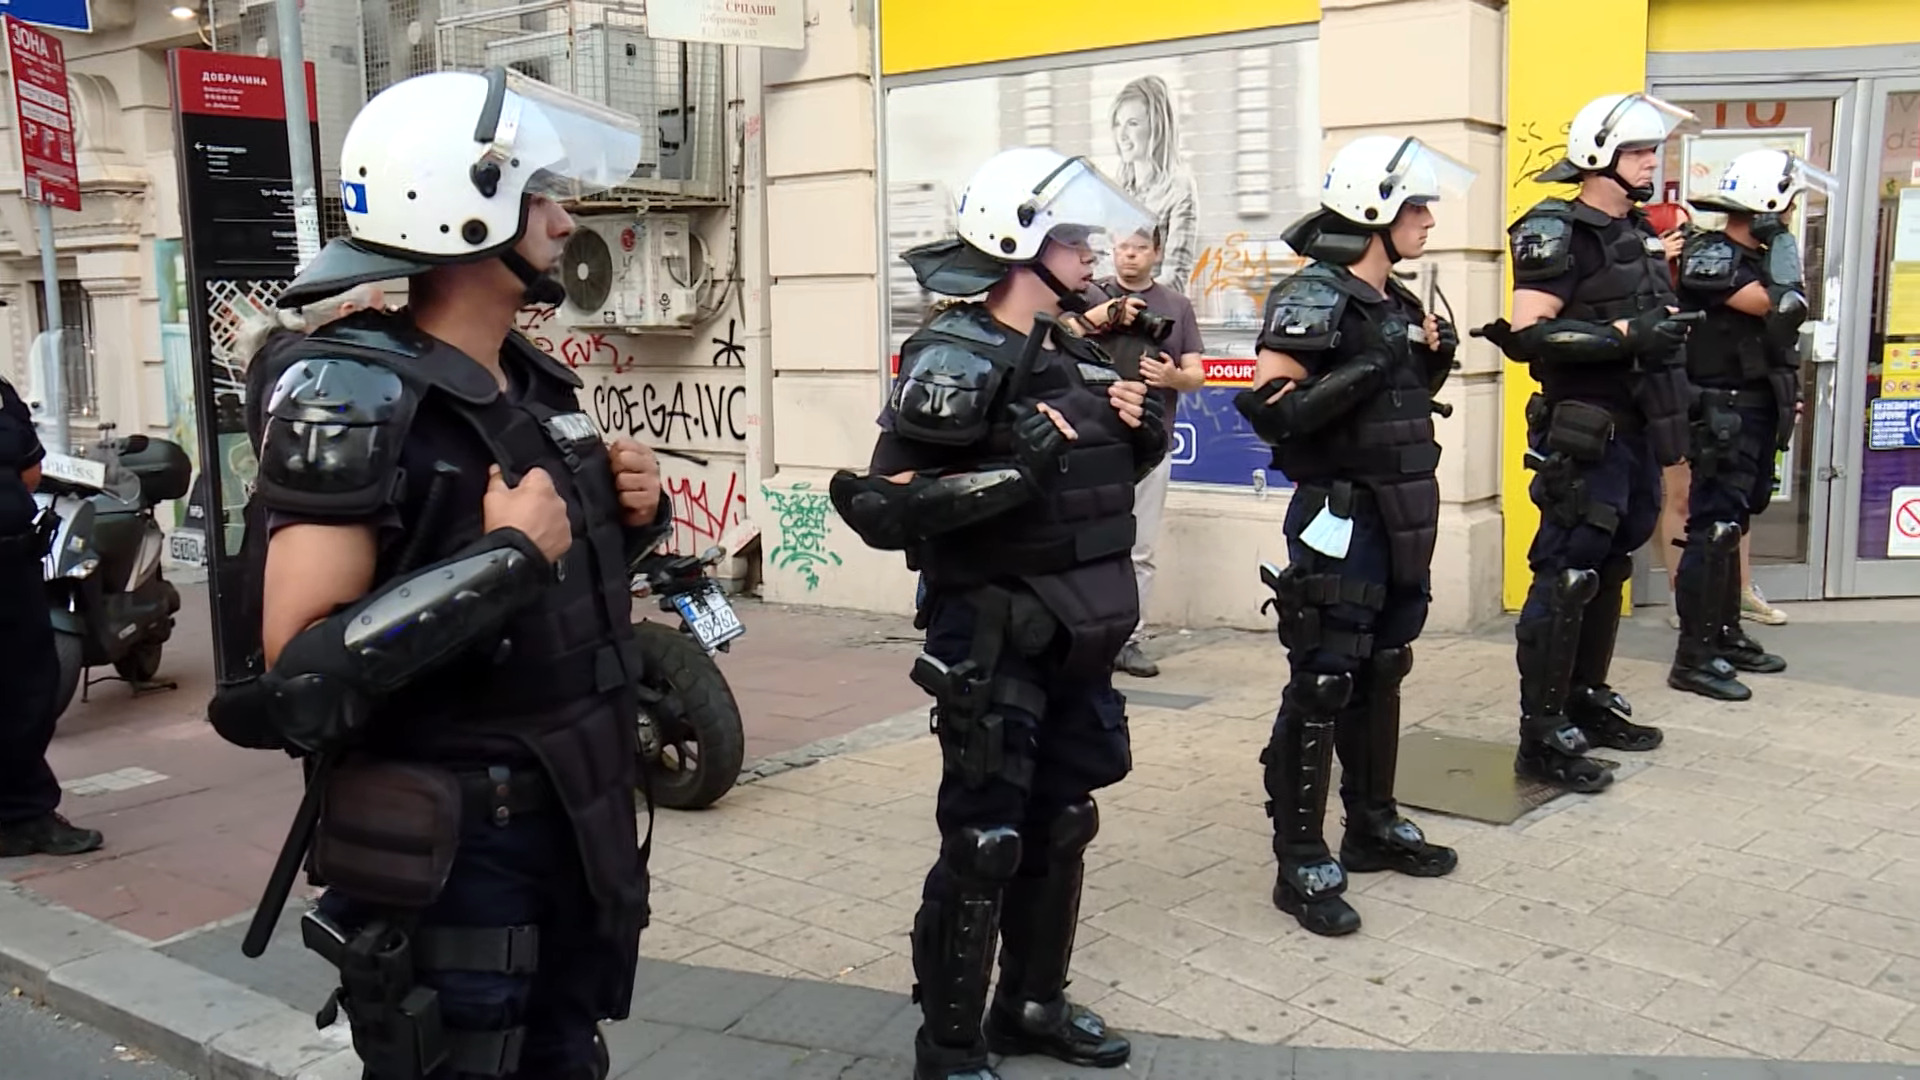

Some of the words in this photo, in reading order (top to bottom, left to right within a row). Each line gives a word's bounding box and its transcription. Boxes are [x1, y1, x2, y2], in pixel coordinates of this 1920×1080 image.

[10, 23, 49, 58] ЗОНА
[55, 45, 62, 64] 1
[202, 71, 267, 86] ДОБРАЧИНА
